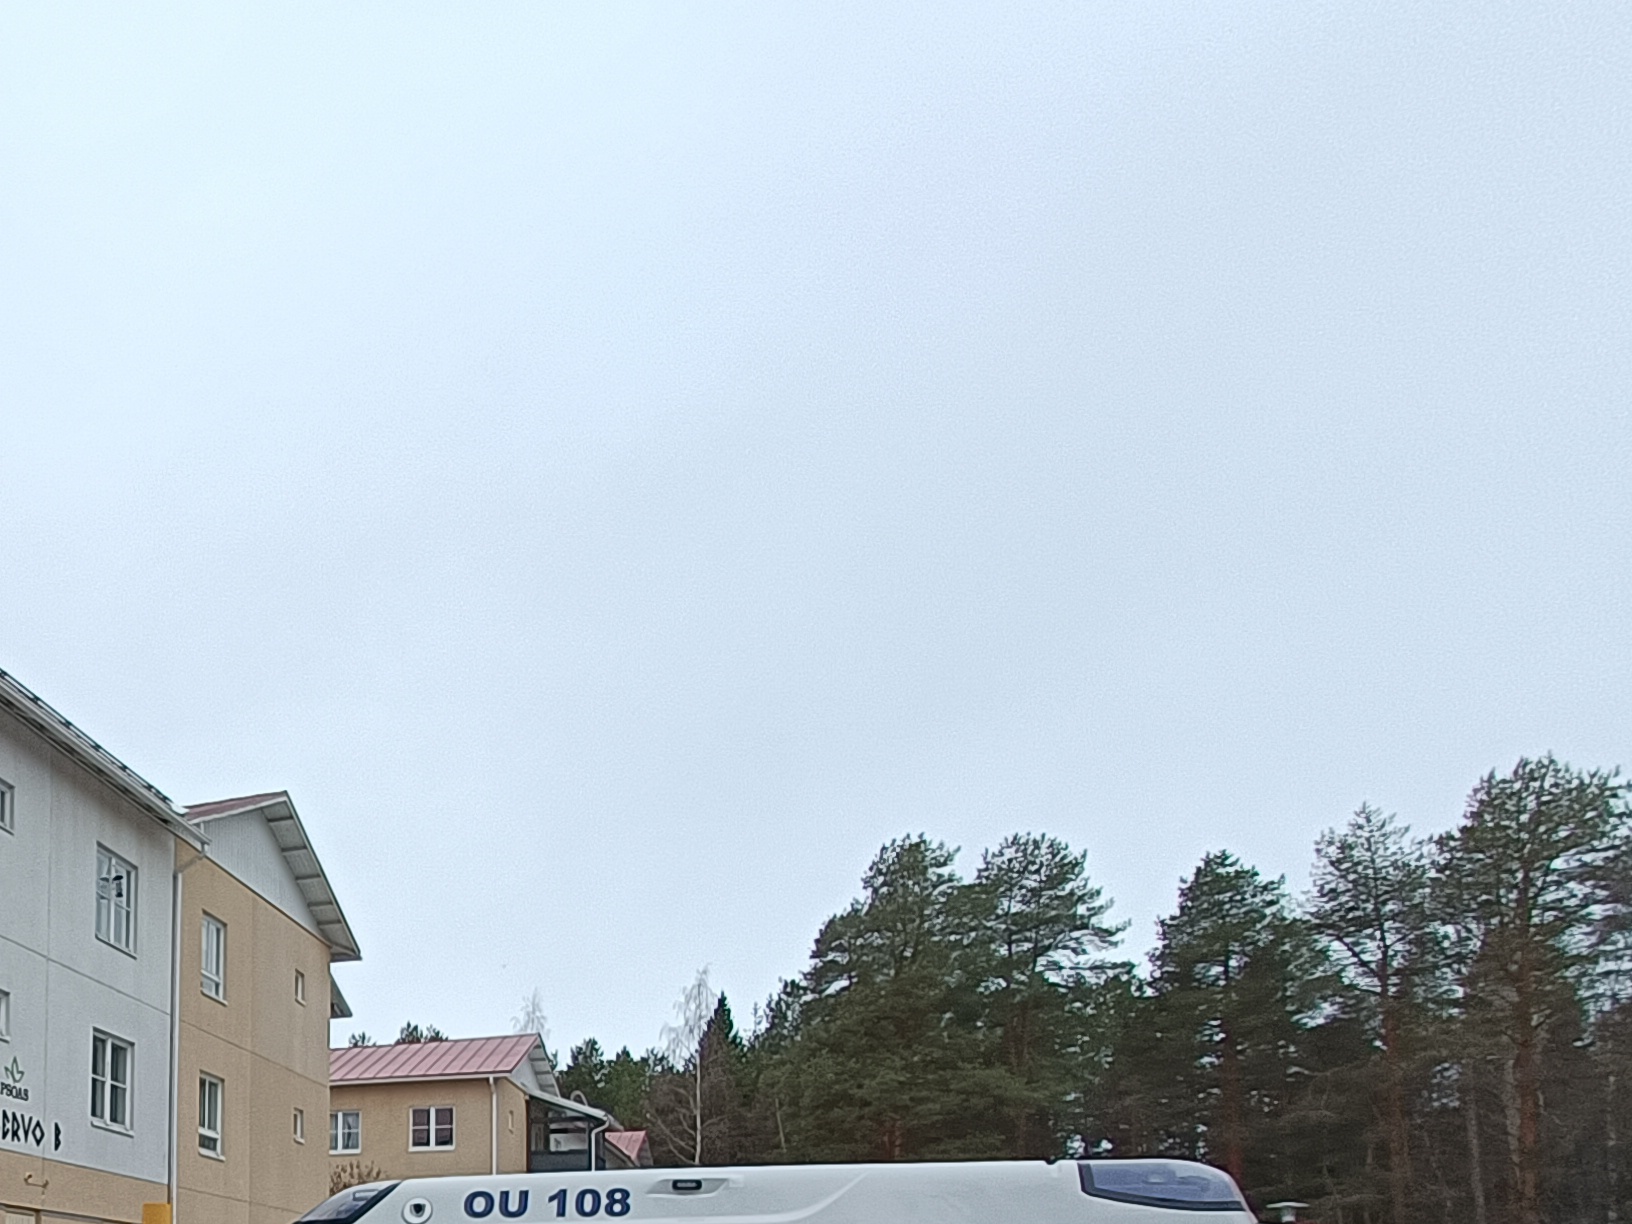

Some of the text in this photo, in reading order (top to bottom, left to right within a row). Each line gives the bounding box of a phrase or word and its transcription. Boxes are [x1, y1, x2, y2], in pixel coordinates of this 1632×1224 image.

[0, 1082, 29, 1101] PSOAS
[54, 1122, 62, 1151] B
[463, 1188, 631, 1218] OU 108
